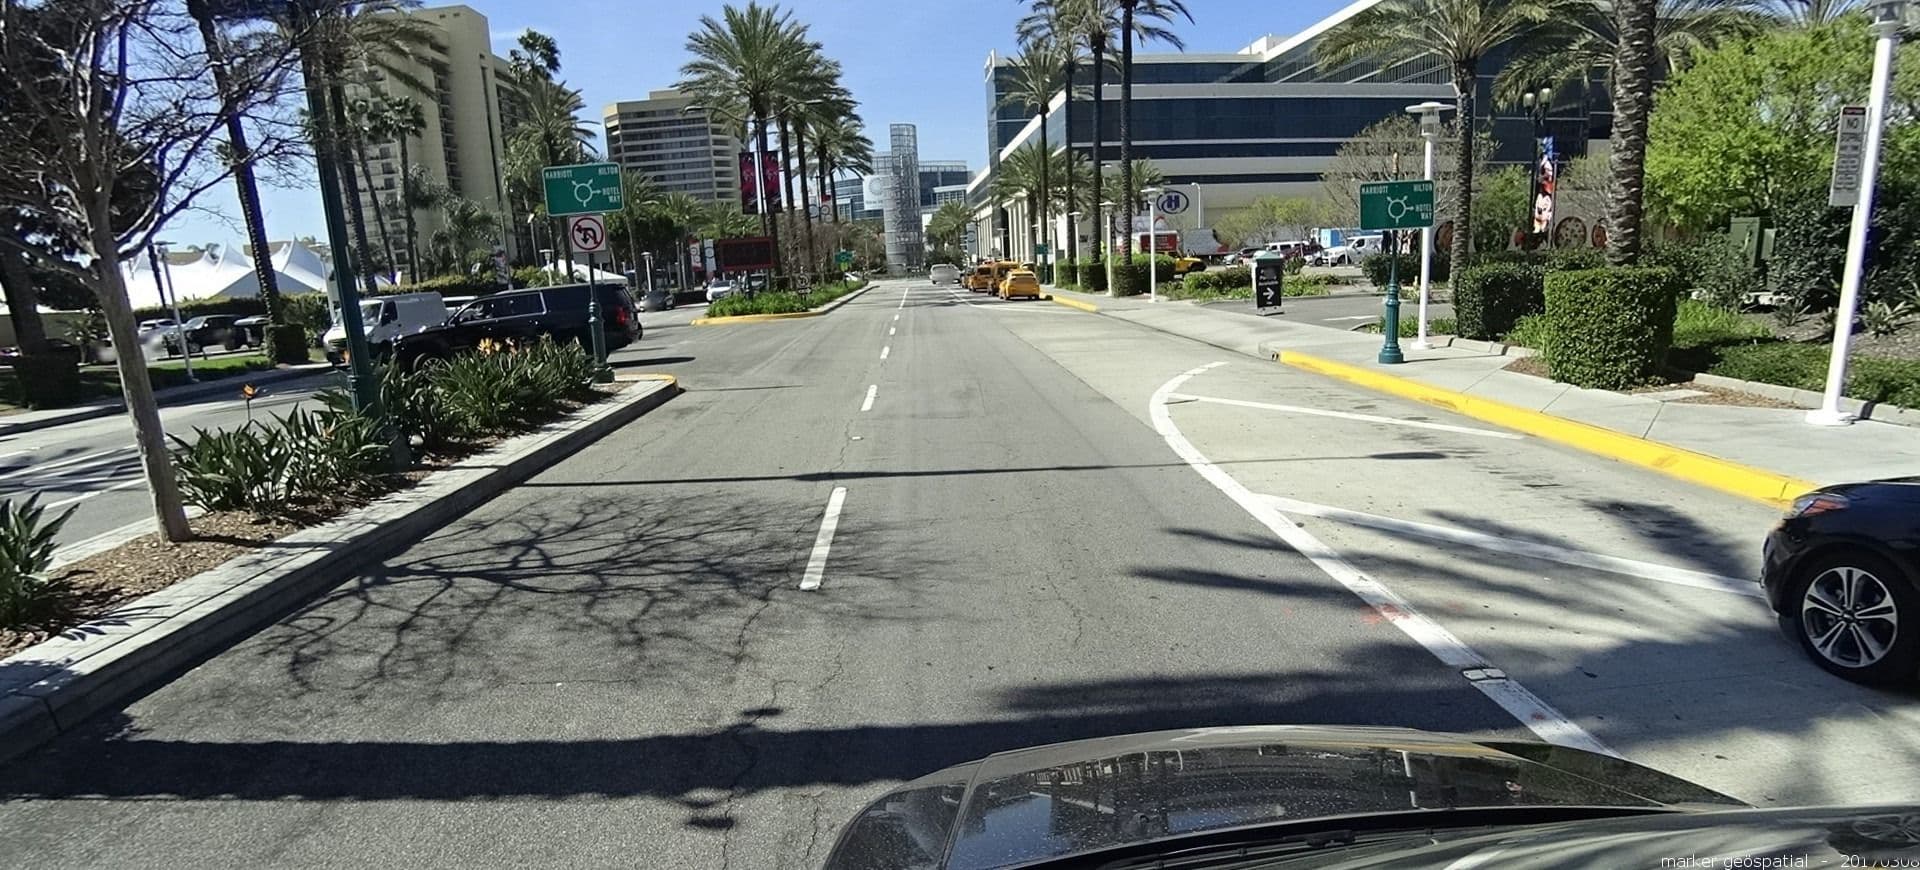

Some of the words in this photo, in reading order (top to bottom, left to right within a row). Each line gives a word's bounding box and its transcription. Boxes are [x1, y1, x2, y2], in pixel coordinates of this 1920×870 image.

[545, 169, 573, 179] MARRIOTT
[598, 167, 618, 175] HILTON
[602, 187, 620, 196] HOTEL
[1361, 185, 1388, 194] MARRIOTT
[1413, 183, 1432, 192] HILTON
[608, 195, 621, 203] WAY
[1415, 203, 1432, 212] HOTEL
[1421, 212, 1432, 220] WAY
